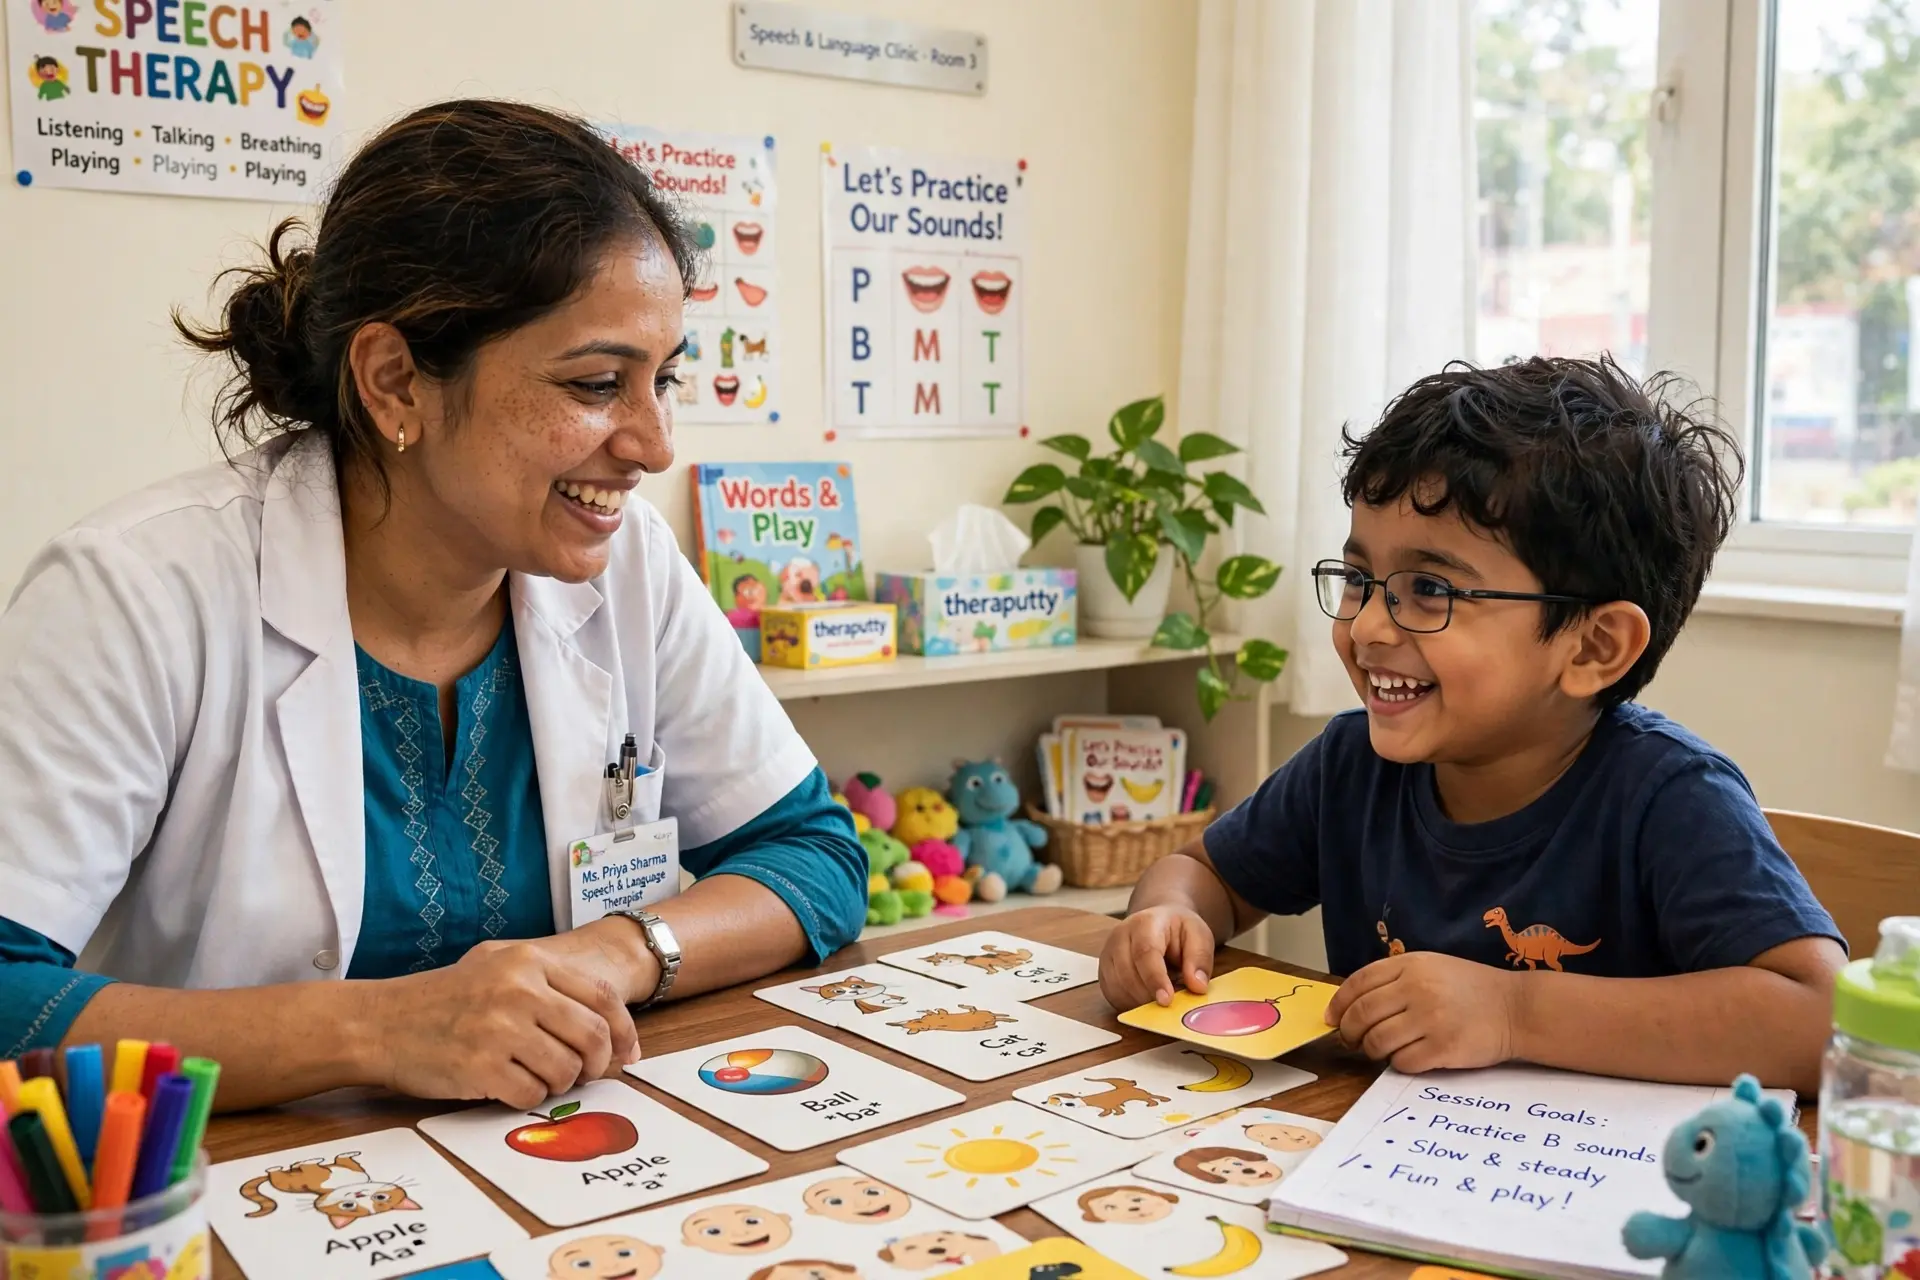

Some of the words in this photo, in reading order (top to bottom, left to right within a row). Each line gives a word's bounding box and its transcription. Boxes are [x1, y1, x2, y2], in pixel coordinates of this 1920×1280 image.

[94, 0, 270, 53] SPEECH
[750, 24, 799, 45] Speech
[805, 31, 814, 47] &
[885, 43, 918, 61] Clinic
[931, 49, 965, 68] Room
[76, 46, 294, 108] THERAPY
[37, 118, 124, 145] Listening
[152, 126, 214, 150] Talking
[241, 133, 321, 158] Breathing
[52, 150, 120, 174] Playing
[153, 155, 217, 180] Playing
[246, 162, 306, 186] Playing
[662, 143, 736, 168] Practice
[653, 169, 727, 194] Sounds!
[844, 162, 903, 196] Let's
[912, 169, 1008, 204] Practice
[851, 203, 899, 233] Our
[907, 207, 1003, 240] Sounds!
[853, 267, 871, 303] P
[852, 326, 871, 361] B
[914, 329, 941, 362] M
[982, 331, 1001, 363] T
[851, 382, 871, 414] T
[914, 383, 941, 415] M
[983, 383, 1001, 414] T
[720, 479, 811, 509] Words
[819, 480, 838, 507] &
[752, 513, 814, 548] Play
[944, 590, 1059, 620] theraputty
[815, 620, 886, 639] theraputty
[582, 870, 600, 884] Ms.
[602, 864, 628, 879] Priya
[630, 854, 667, 871] Sharma
[582, 881, 614, 902] Speech
[616, 880, 623, 891] &
[626, 871, 666, 888] Language
[602, 890, 643, 909] Therapist
[1014, 967, 1053, 978] Cat
[979, 1034, 1028, 1048] Cat
[801, 1090, 860, 1113] Ball
[1418, 1086, 1511, 1112] Session
[1527, 1103, 1609, 1128] Goals:
[1428, 1114, 1526, 1143] Practice
[1543, 1134, 1560, 1148] B
[1574, 1139, 1657, 1165] sounds
[580, 1153, 671, 1187] Apple
[1389, 1164, 1438, 1188] Fun
[1456, 1177, 1476, 1194] &
[1408, 1140, 1469, 1163] Slow
[1483, 1153, 1501, 1168] &
[1518, 1158, 1607, 1188] steady
[324, 1220, 427, 1255] Apple
